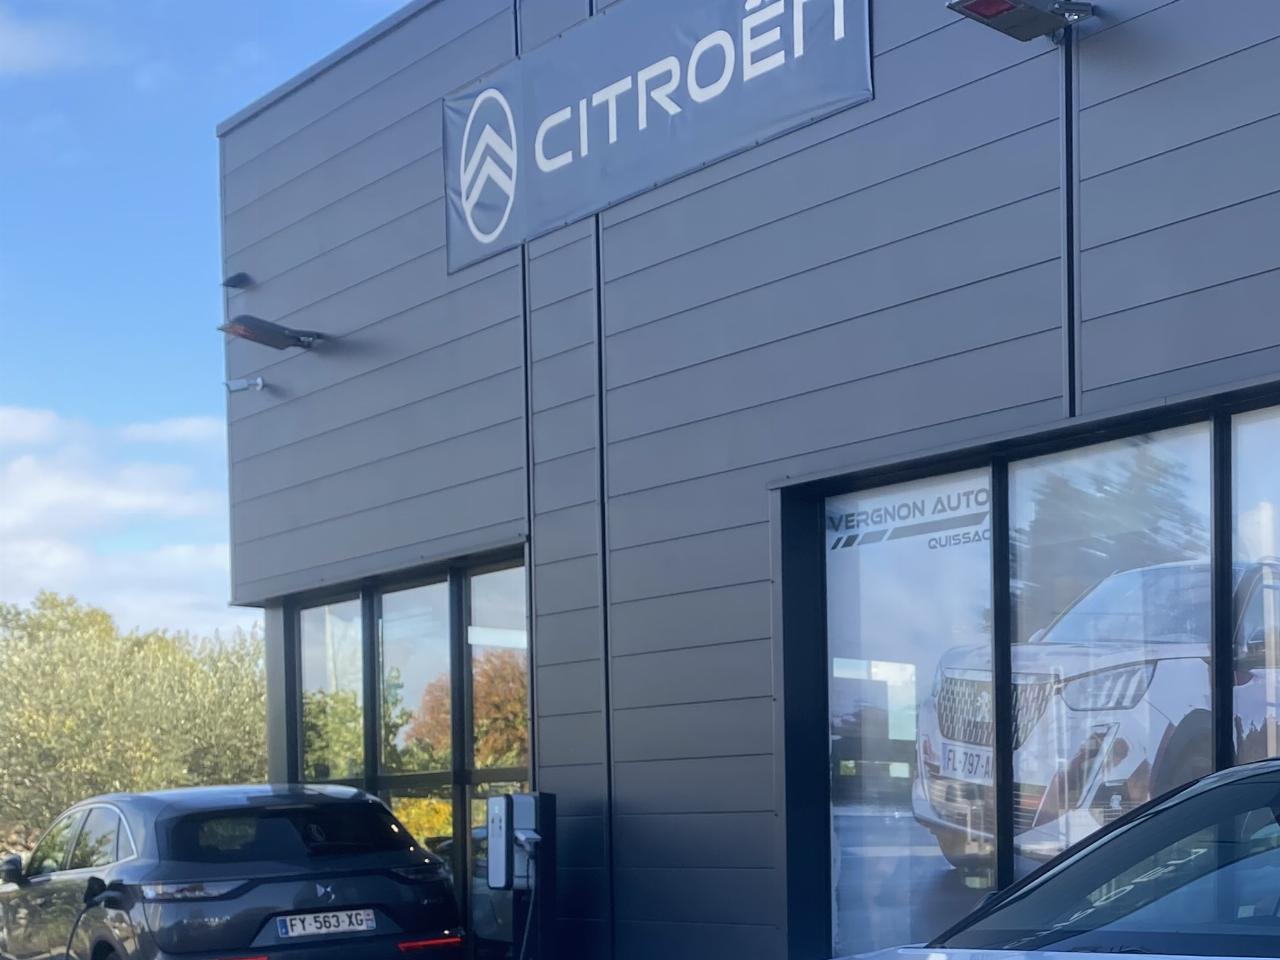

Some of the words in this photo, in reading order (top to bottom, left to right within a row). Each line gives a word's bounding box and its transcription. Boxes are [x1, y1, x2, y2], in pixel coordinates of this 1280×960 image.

[829, 500, 925, 532] VERGNON
[932, 488, 990, 514] AUTO
[928, 529, 991, 549] QUISSAC
